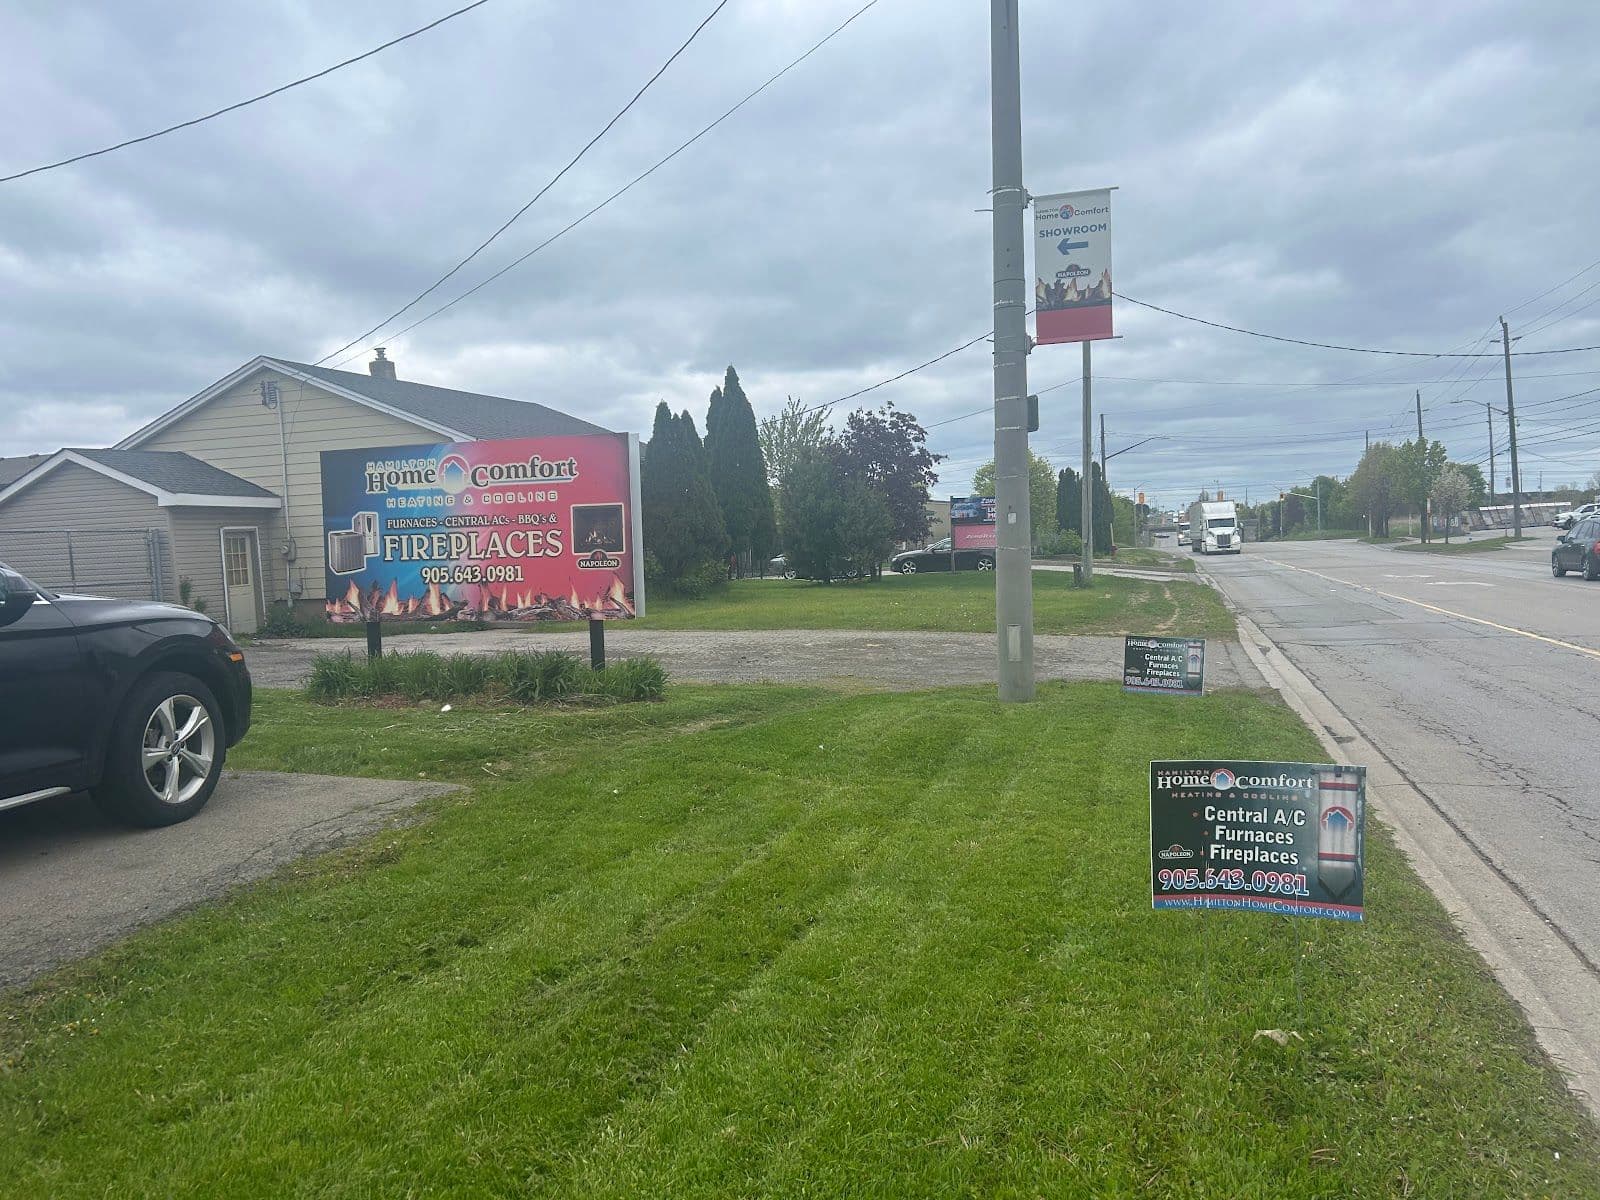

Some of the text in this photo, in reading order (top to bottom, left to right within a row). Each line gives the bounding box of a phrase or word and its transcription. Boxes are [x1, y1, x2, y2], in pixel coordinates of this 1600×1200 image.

[1074, 206, 1109, 216] Comfort
[1039, 223, 1107, 238] SHOWROOM
[366, 459, 436, 471] HAMILTON
[366, 455, 577, 492] Home Comfort
[386, 491, 558, 508] HEATING & COOLING
[387, 518, 437, 529] FURNACES
[445, 516, 491, 527] CENTRAL
[492, 516, 510, 526] ACs
[518, 514, 547, 525] BBQ's
[549, 513, 557, 523] &
[383, 530, 563, 562] FIREPLACES
[421, 566, 524, 584] 905.643.0981
[1145, 653, 1169, 662] Central
[1149, 661, 1178, 669] Furnaces
[1147, 668, 1180, 677] Fireplaces
[1157, 774, 1313, 789] Home Comfort
[1171, 791, 1222, 799] HEATING
[1243, 792, 1298, 801] COOLING
[1204, 806, 1306, 826] Central A/C
[1215, 825, 1294, 844] Furnaces
[1210, 844, 1299, 865] Fireplaces
[1158, 868, 1310, 896] 905.643.0981
